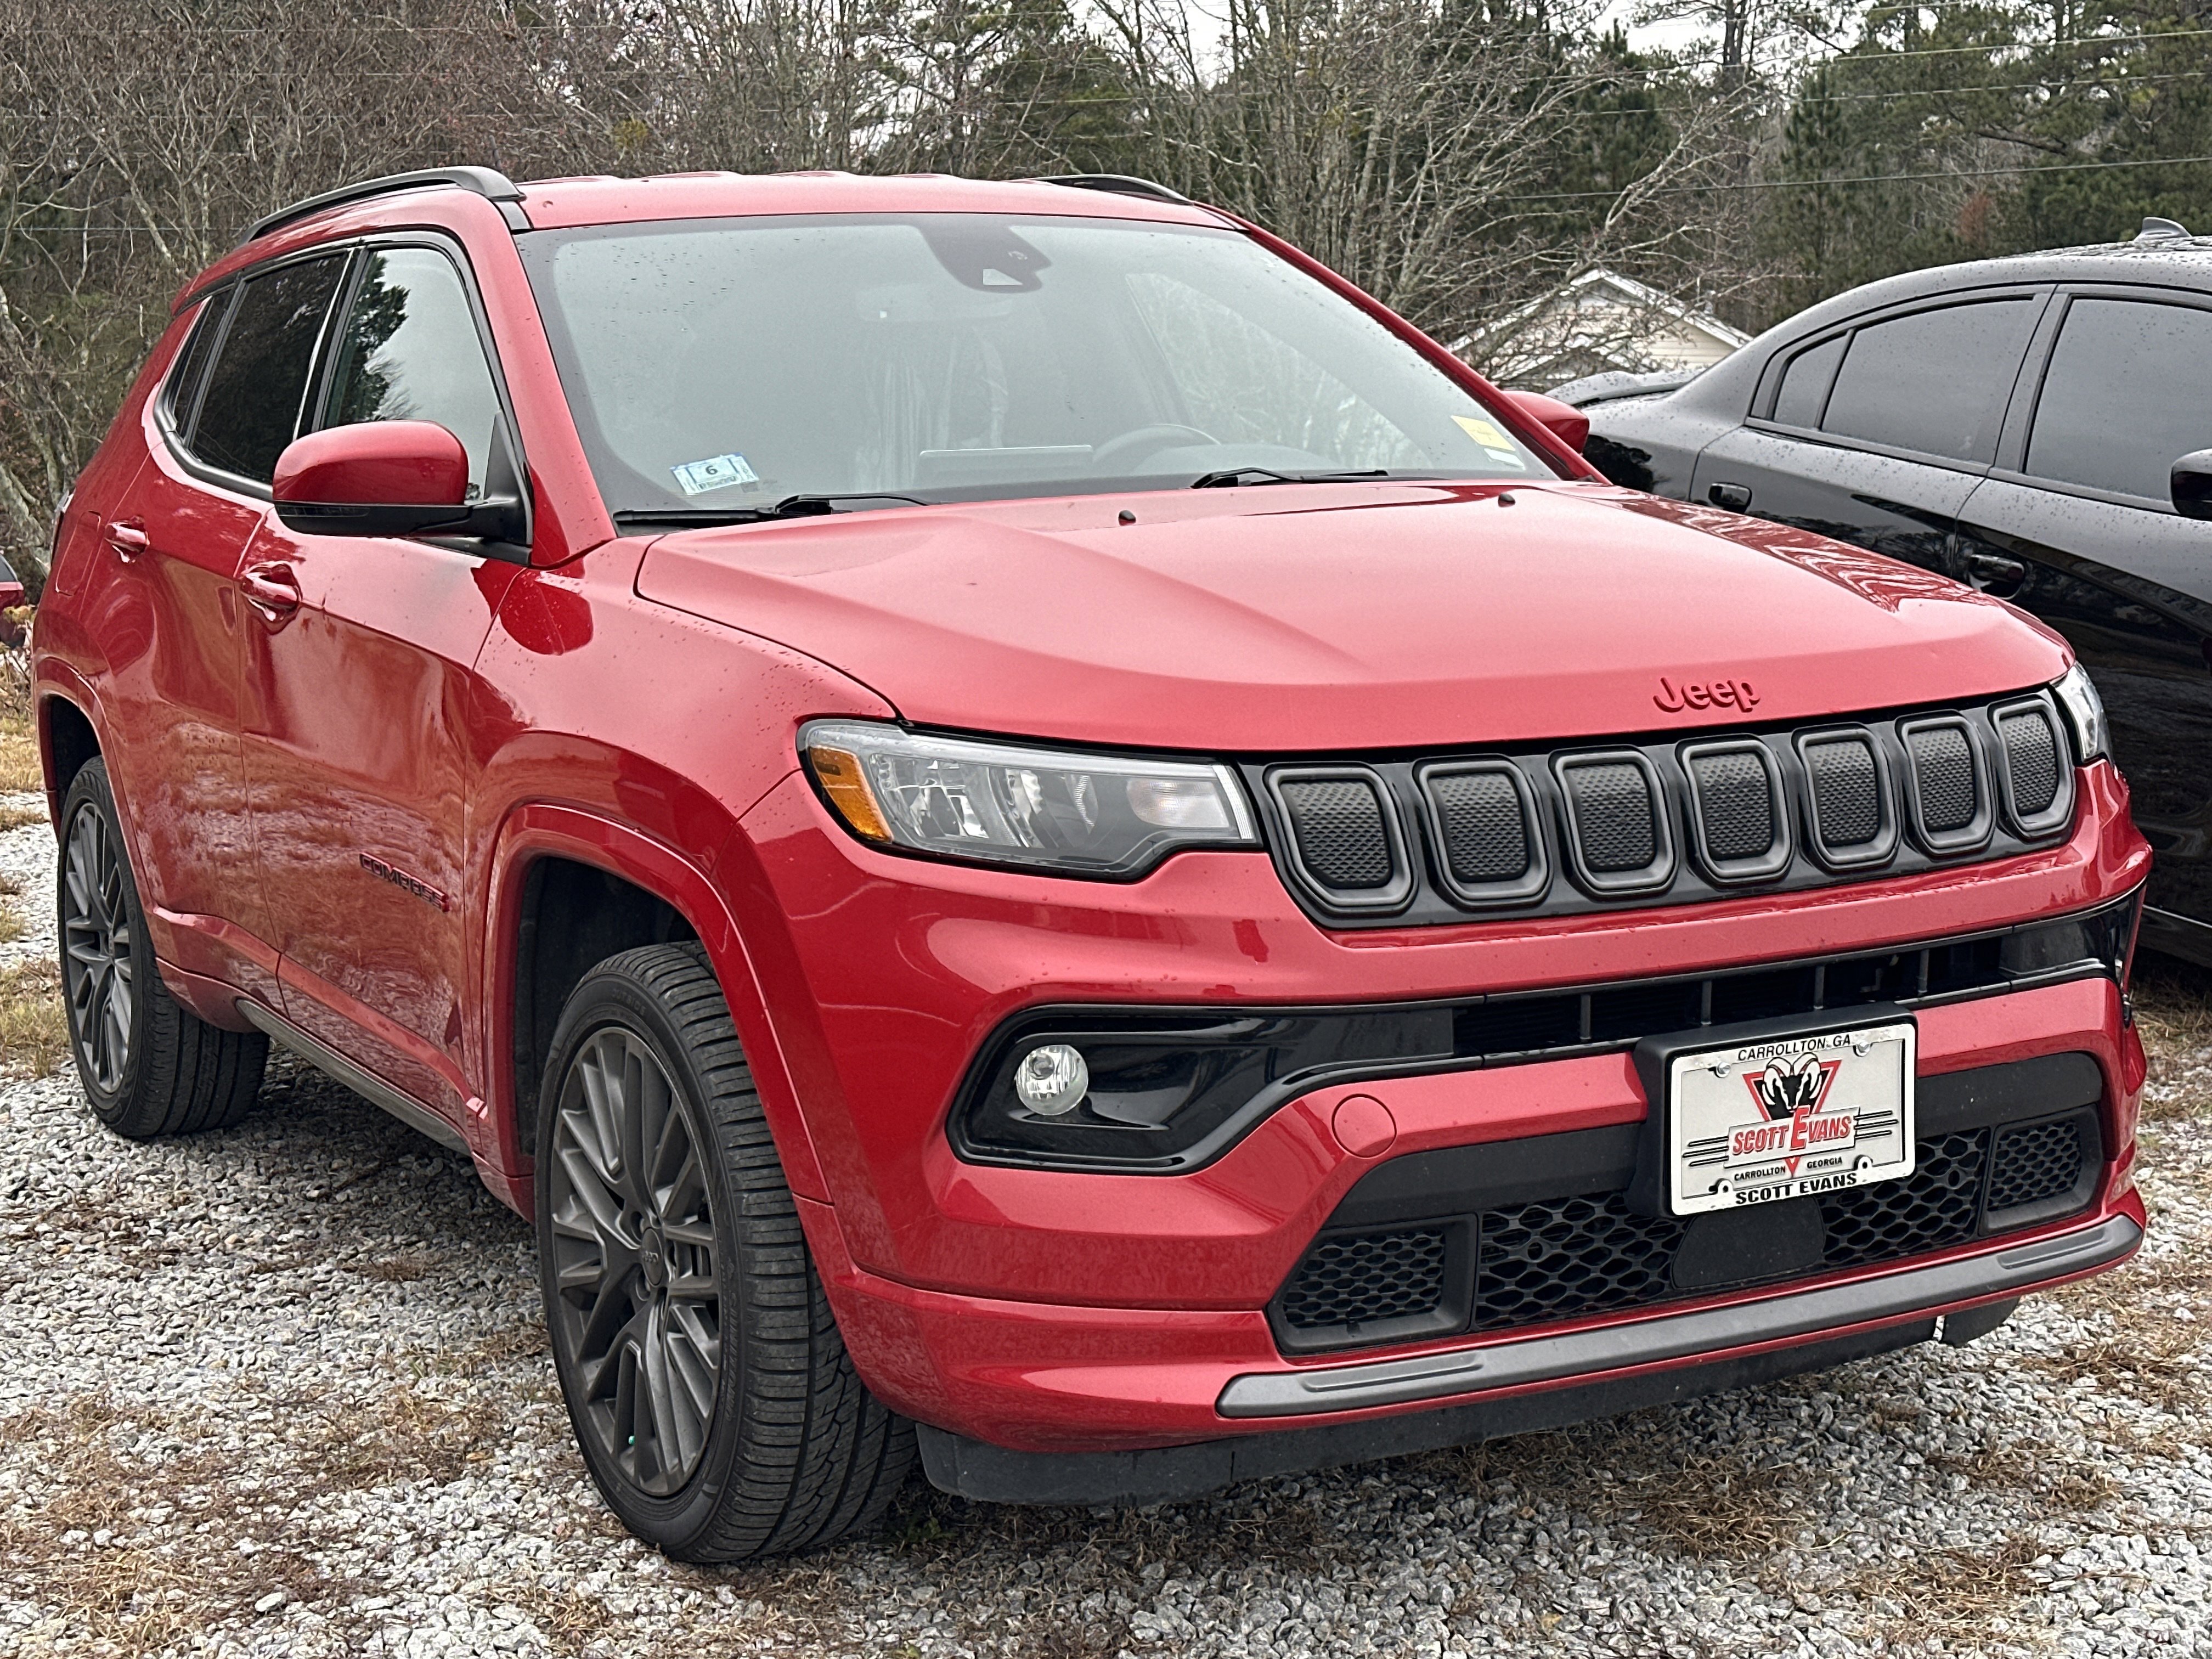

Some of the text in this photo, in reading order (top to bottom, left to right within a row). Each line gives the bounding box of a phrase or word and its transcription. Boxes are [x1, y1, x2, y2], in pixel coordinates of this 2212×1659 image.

[706, 465, 718, 475] 6
[1652, 677, 1760, 713] Jeep
[1833, 1034, 1851, 1047] GA
[1733, 1104, 1853, 1156] SCOTT EVANS
[1807, 1156, 1843, 1169] GEORGIA
[1734, 1166, 1786, 1181] CARROLLTON
[1735, 1172, 1858, 1205] SCOTT EVANS
